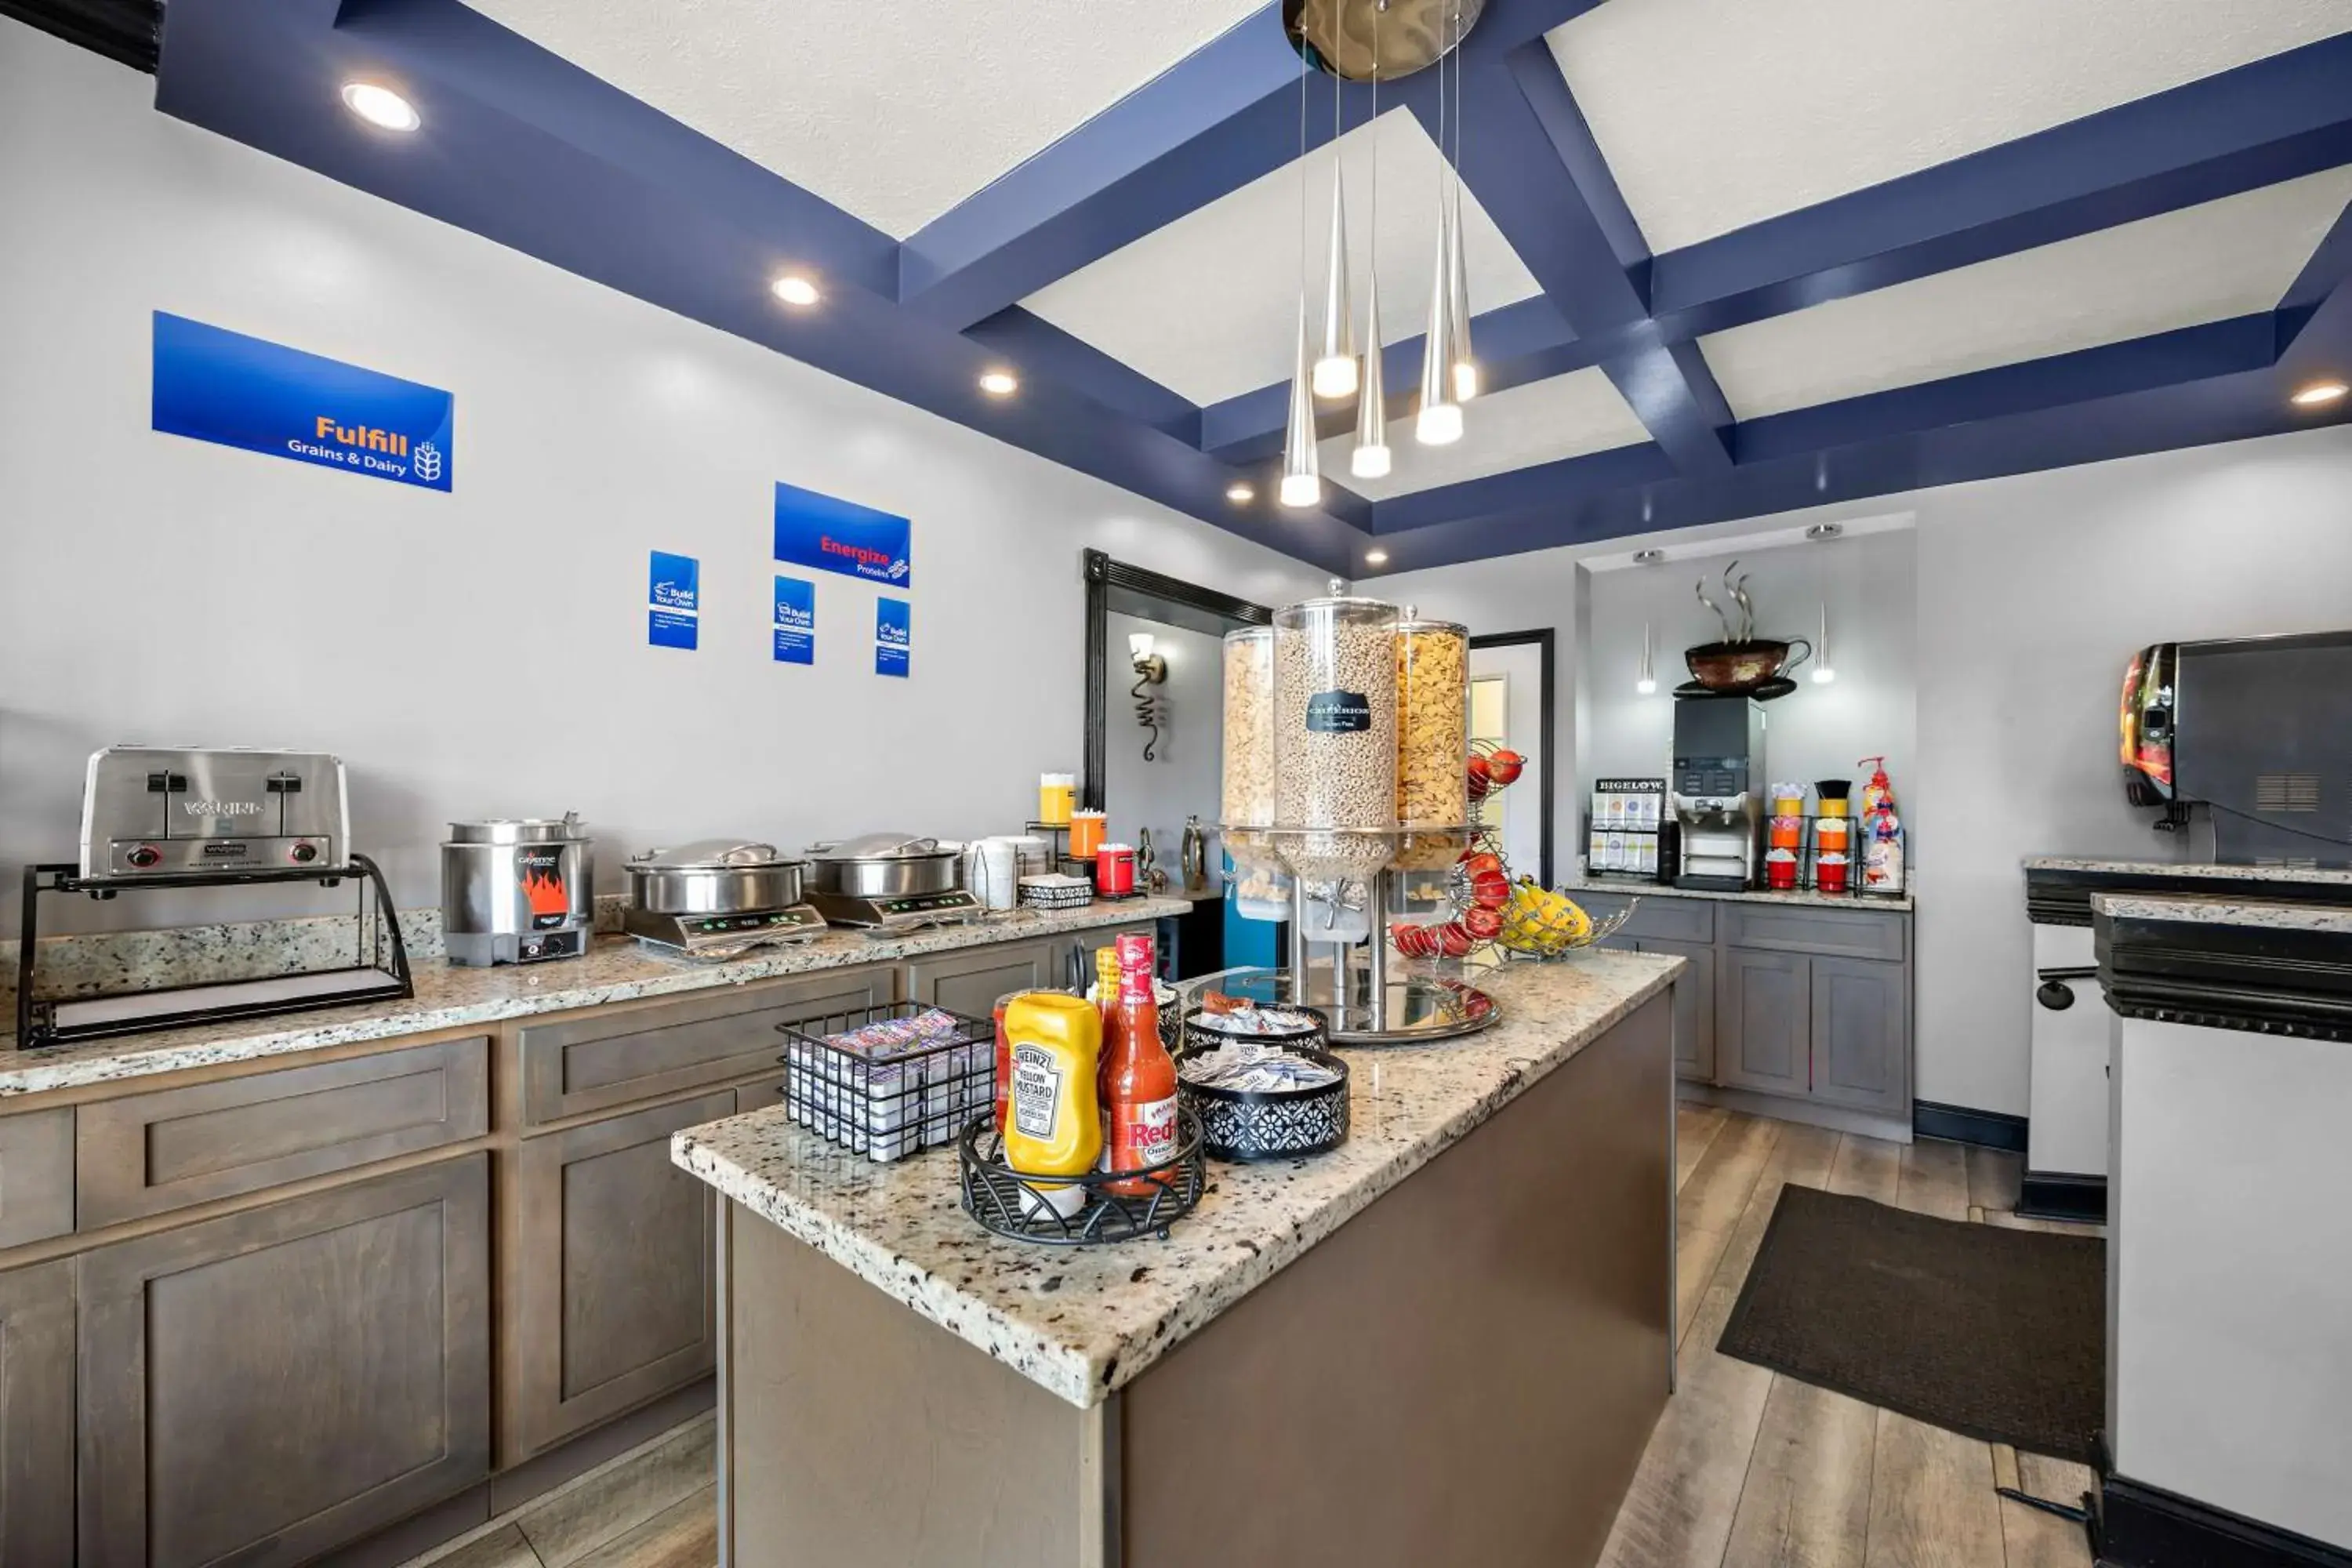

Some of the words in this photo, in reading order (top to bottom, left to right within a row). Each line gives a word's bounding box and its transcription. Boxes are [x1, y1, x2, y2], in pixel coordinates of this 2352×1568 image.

[316, 416, 407, 458] Fulfill
[288, 439, 343, 462] Grains
[347, 452, 360, 465] &
[364, 456, 407, 477] Dairy
[820, 533, 890, 566] Energize
[857, 564, 889, 579] Proteins
[655, 594, 673, 604] Your
[674, 597, 694, 608] Own
[670, 589, 694, 600] Build
[791, 608, 811, 619] Build
[1599, 781, 1661, 789] BIGELOW
[1018, 1051, 1047, 1069] HEINZ
[1019, 1069, 1046, 1083] YELLOW
[1017, 1080, 1053, 1098] MUSTARD
